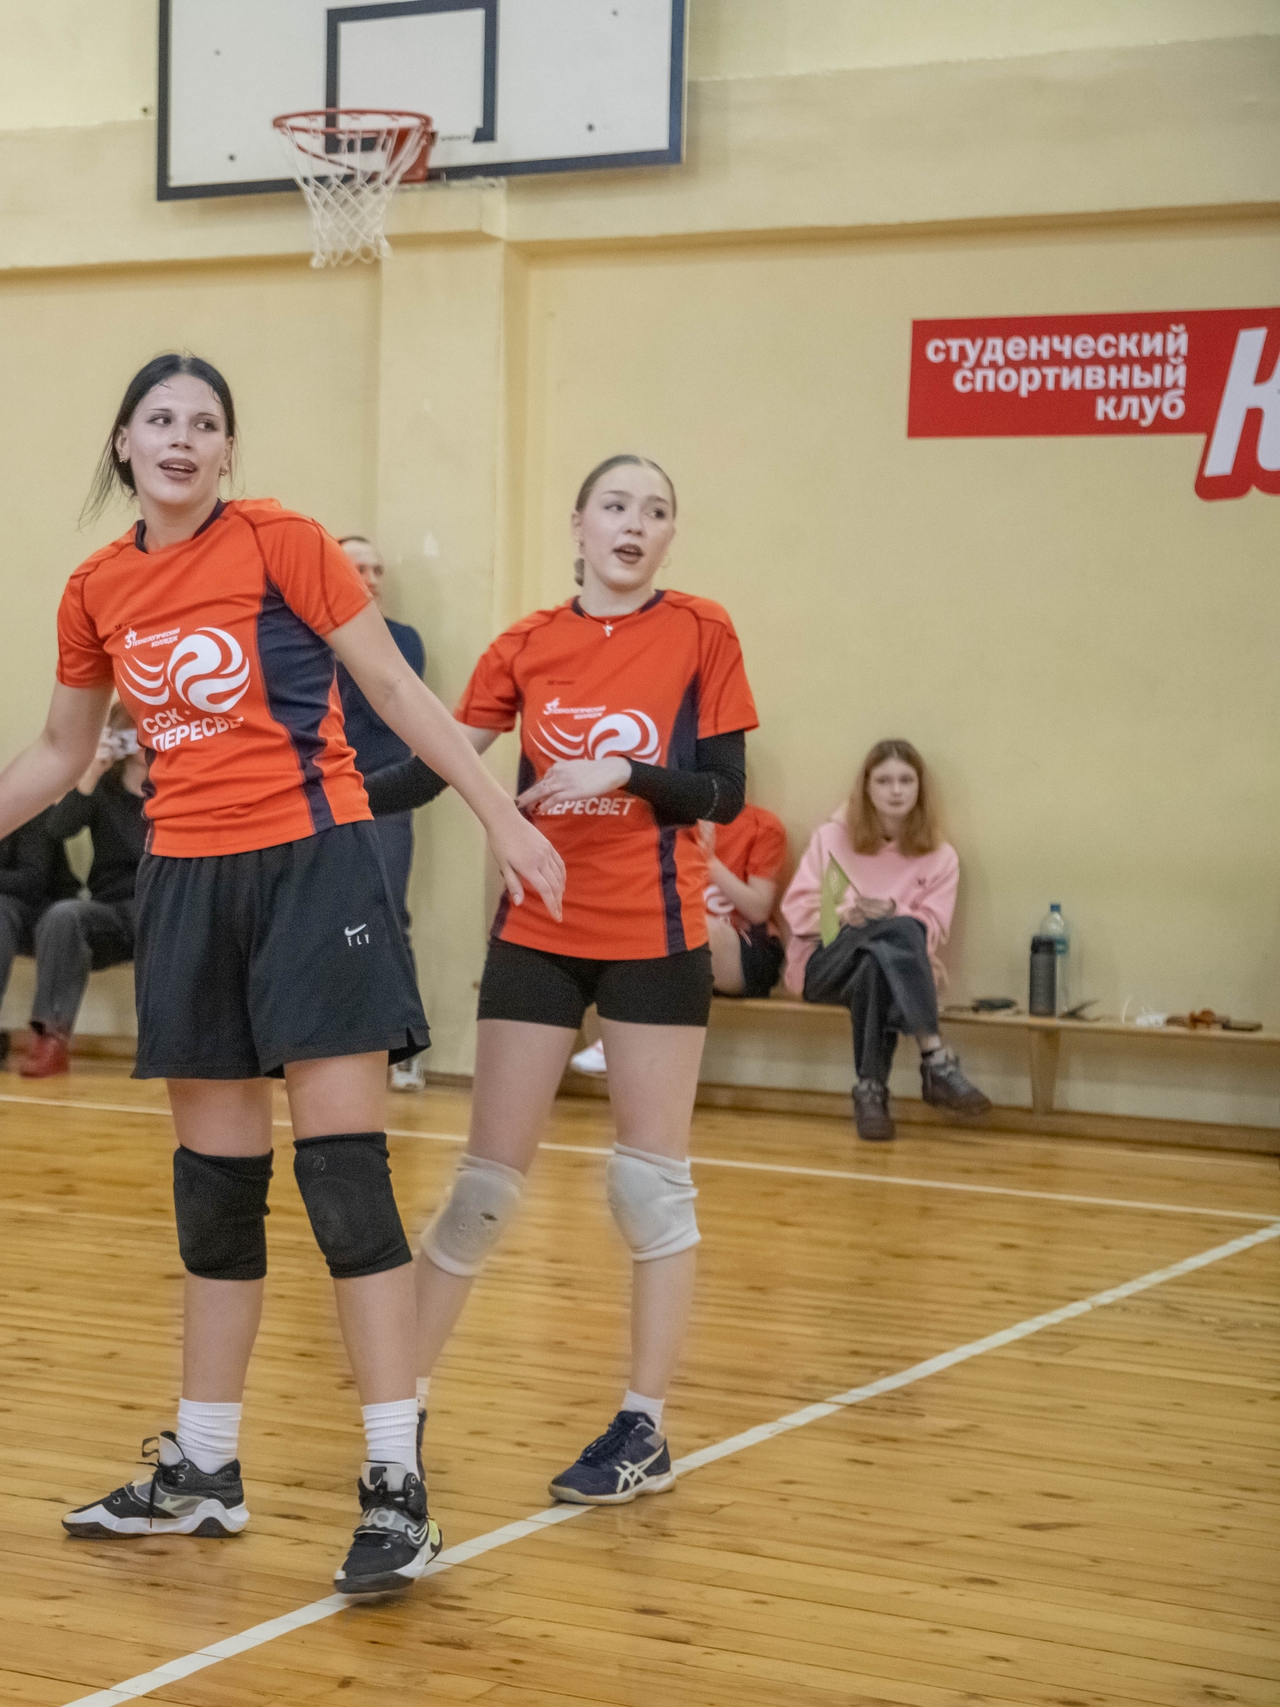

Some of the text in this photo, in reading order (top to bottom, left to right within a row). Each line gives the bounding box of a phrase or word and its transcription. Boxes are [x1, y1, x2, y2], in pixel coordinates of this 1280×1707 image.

[925, 323, 1189, 368] студенческий
[953, 356, 1187, 398] спортивный
[1095, 389, 1186, 427] клуб
[142, 708, 185, 734] ССК
[151, 716, 244, 752] ПЕРЕСВЕ
[538, 797, 636, 817] ЕРЕСВЕТ
